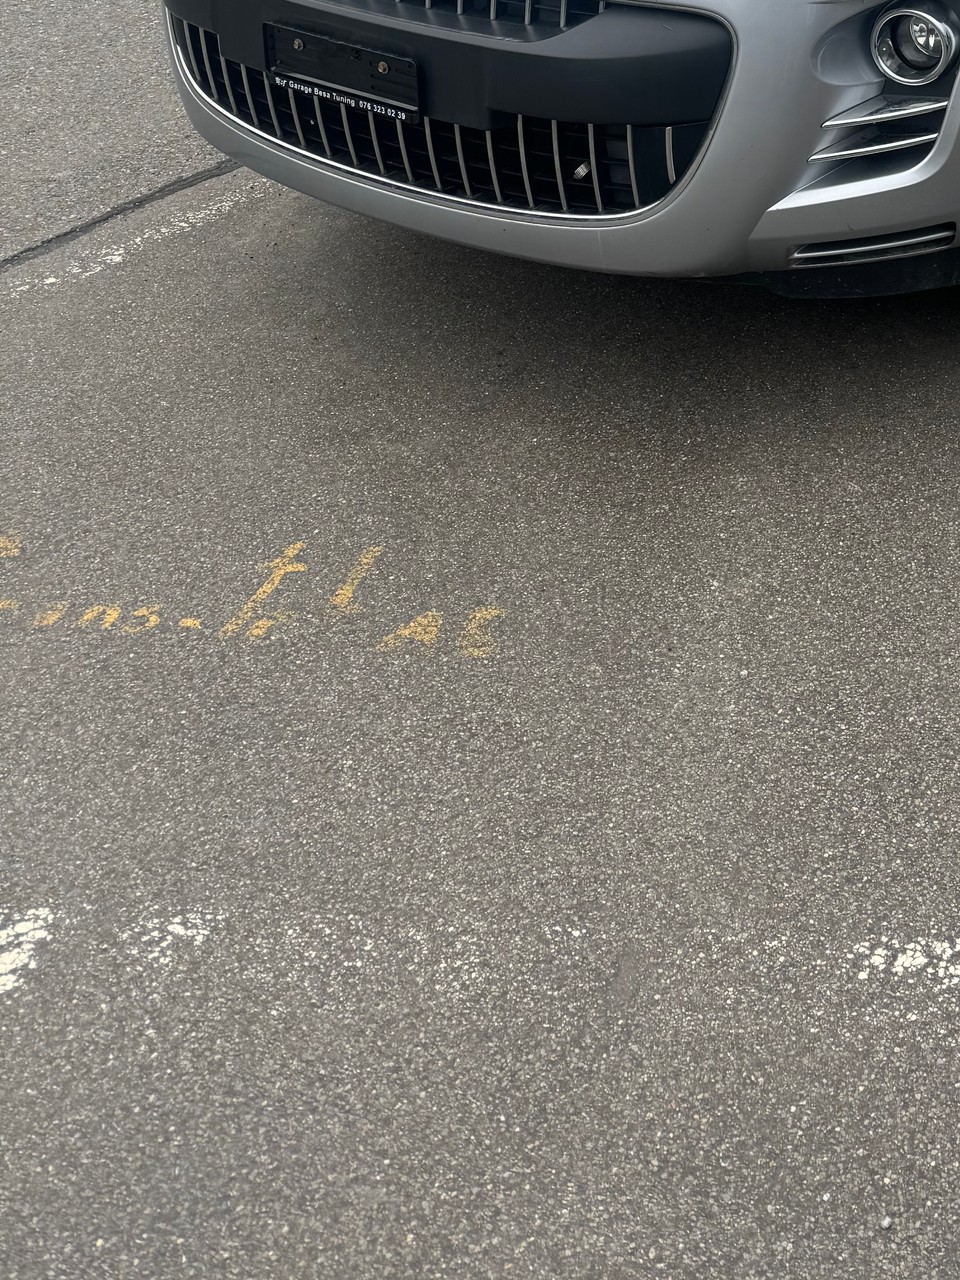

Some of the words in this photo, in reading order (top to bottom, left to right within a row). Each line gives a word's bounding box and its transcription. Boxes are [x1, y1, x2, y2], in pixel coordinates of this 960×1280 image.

[289, 80, 313, 94] Garage
[314, 87, 331, 99] Besa
[332, 92, 356, 107] Tuning
[359, 100, 372, 111] 076
[373, 104, 386, 115] 323
[387, 108, 396, 118] 02
[397, 112, 406, 120] 39
